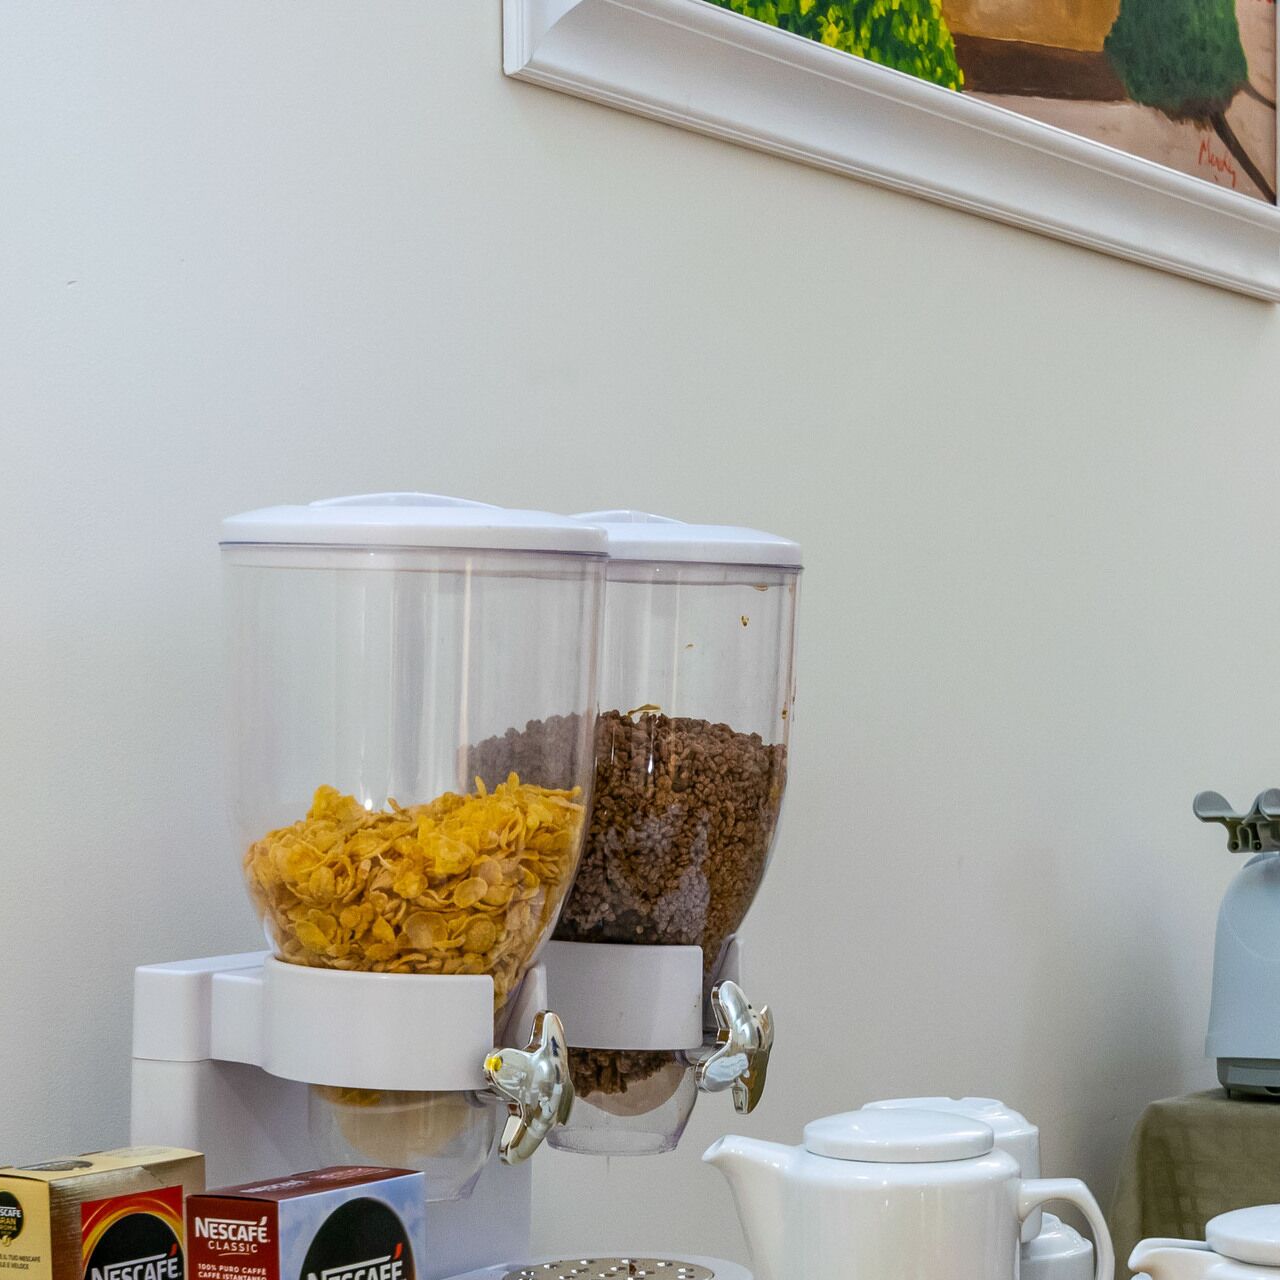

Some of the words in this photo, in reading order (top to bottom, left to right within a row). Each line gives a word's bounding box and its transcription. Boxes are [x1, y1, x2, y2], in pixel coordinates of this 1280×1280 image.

[194, 1215, 271, 1244] NESCAFÉ
[207, 1240, 259, 1253] CLASSIC
[198, 1263, 218, 1271] 100%
[219, 1265, 240, 1273] PURO
